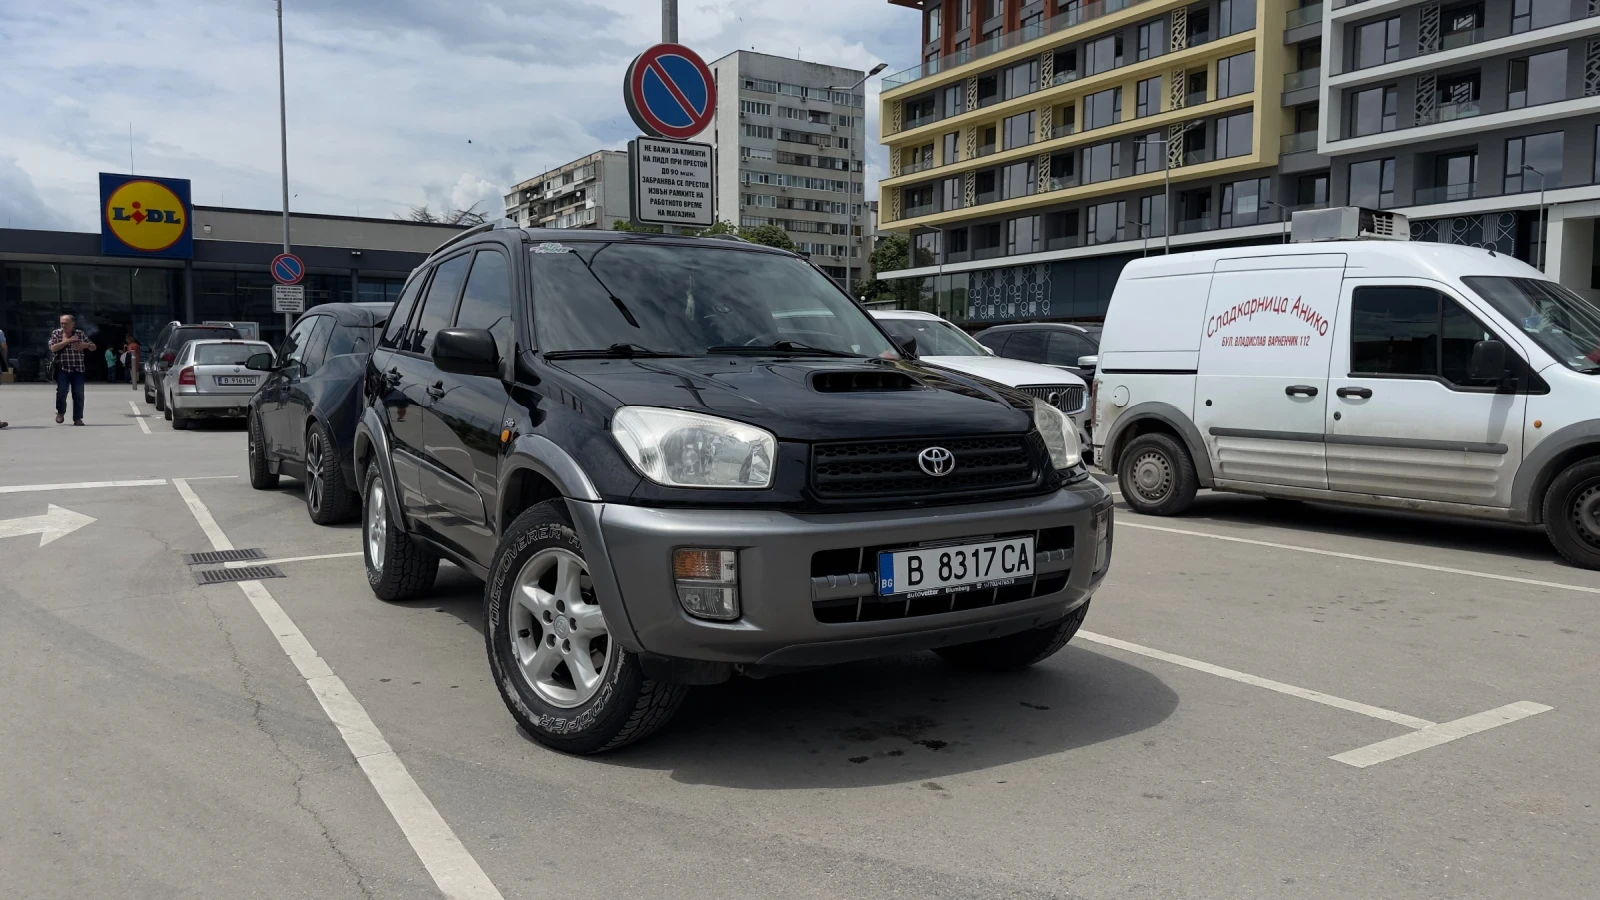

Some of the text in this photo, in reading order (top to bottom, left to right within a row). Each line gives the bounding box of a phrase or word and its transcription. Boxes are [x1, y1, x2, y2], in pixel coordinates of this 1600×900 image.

[653, 146, 670, 154] ВАЖИ
[680, 148, 706, 157] КЛИЕНТИ
[652, 156, 669, 164] ЛИДЛ
[683, 159, 708, 168] ПРЕСТОЙ
[642, 176, 675, 185] ЗАБРАНЯВА
[669, 189, 695, 198] РАМКИТЕ
[650, 198, 682, 207] РАБОТНОТО
[667, 210, 696, 218] МАГАЗИНА
[1207, 295, 1328, 338] Сладкарница Анико
[1234, 336, 1266, 347] ВЛАДИСЛАВ
[1268, 336, 1298, 346] ВАРНЕНЧИК
[1300, 336, 1310, 346] 112
[908, 556, 924, 586] B
[881, 578, 893, 589] BG
[945, 585, 970, 594] Blumberg
[539, 682, 613, 730] COOPER
